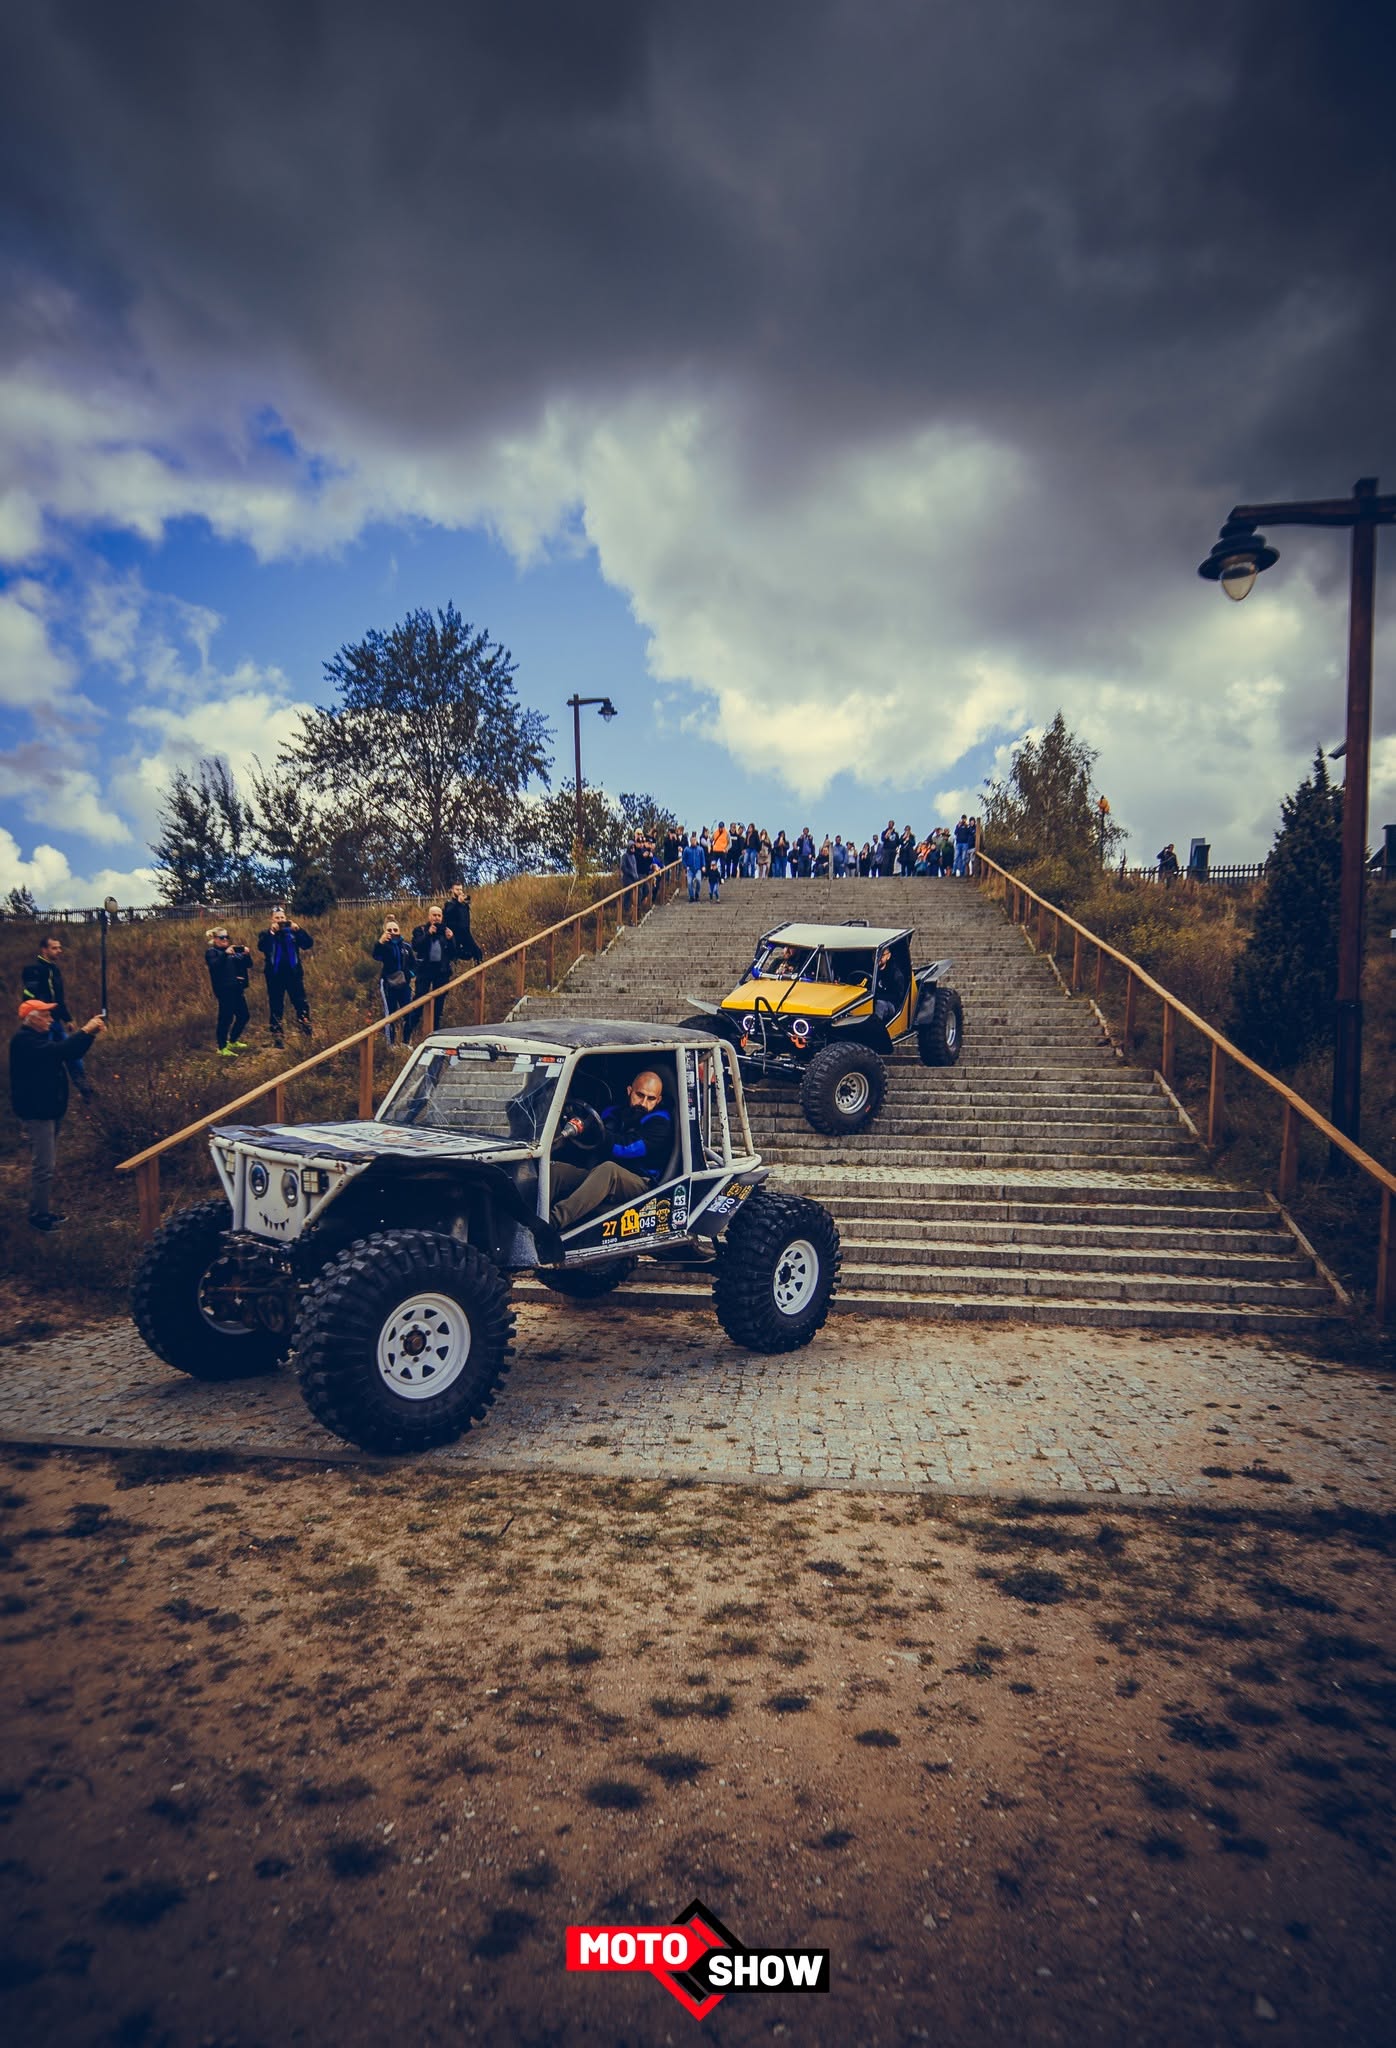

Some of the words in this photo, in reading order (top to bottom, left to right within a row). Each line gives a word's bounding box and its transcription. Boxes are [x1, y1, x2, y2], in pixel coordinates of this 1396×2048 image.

[718, 1198, 735, 1213] 070
[603, 1221, 617, 1236] 27
[640, 1216, 655, 1229] 045
